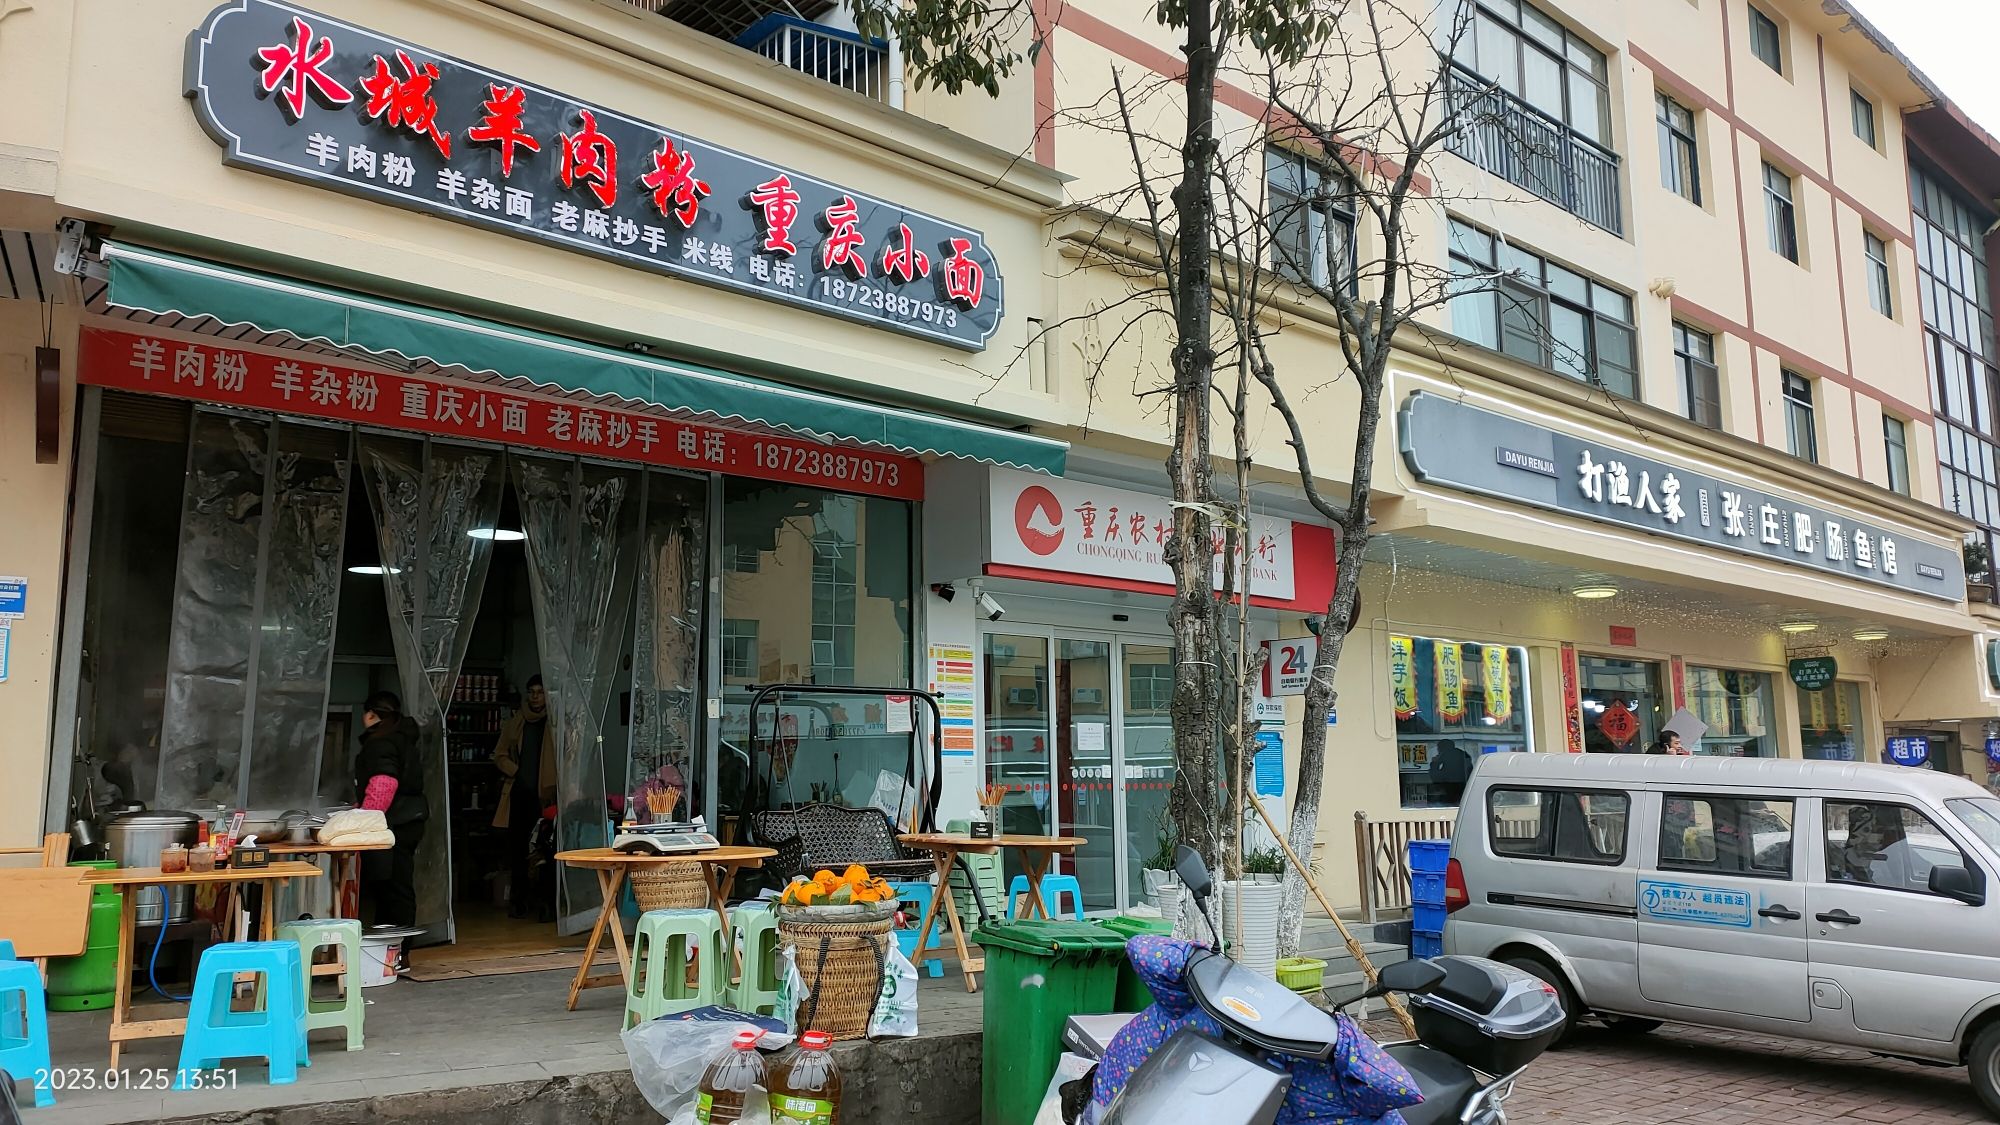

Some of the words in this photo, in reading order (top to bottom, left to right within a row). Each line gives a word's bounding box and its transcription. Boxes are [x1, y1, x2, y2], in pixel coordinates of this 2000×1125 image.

[256, 15, 711, 229] 水城羊肉粉
[750, 174, 984, 309] 重庆小面
[305, 132, 416, 189] 羊肉粉
[436, 167, 534, 222] 羊杂面
[551, 200, 668, 255] 老麻抄手
[682, 236, 734, 275] 米线
[819, 274, 958, 329] 18723887973
[129, 338, 249, 393] 羊肉粉
[271, 360, 380, 412] 羊杂粉
[399, 381, 529, 435] 重庆小面
[546, 404, 660, 454] 老麻抄手
[752, 440, 900, 488] 18723887973
[1505, 451, 1528, 467] DAYU
[1528, 455, 1555, 474] RENJIA
[1576, 449, 1686, 525] 打渔人家
[1719, 490, 1898, 575] 张庄肥肠鱼馆
[1076, 542, 1142, 563] CHONGQING
[1253, 566, 1278, 581] BANK
[1280, 645, 1308, 675] 24
[1391, 641, 1410, 708] 洋芋饭
[1441, 646, 1459, 710] 肥肠鱼
[1608, 712, 1627, 731] 福
[1892, 738, 1926, 760] 超市
[1646, 892, 1656, 905] 7
